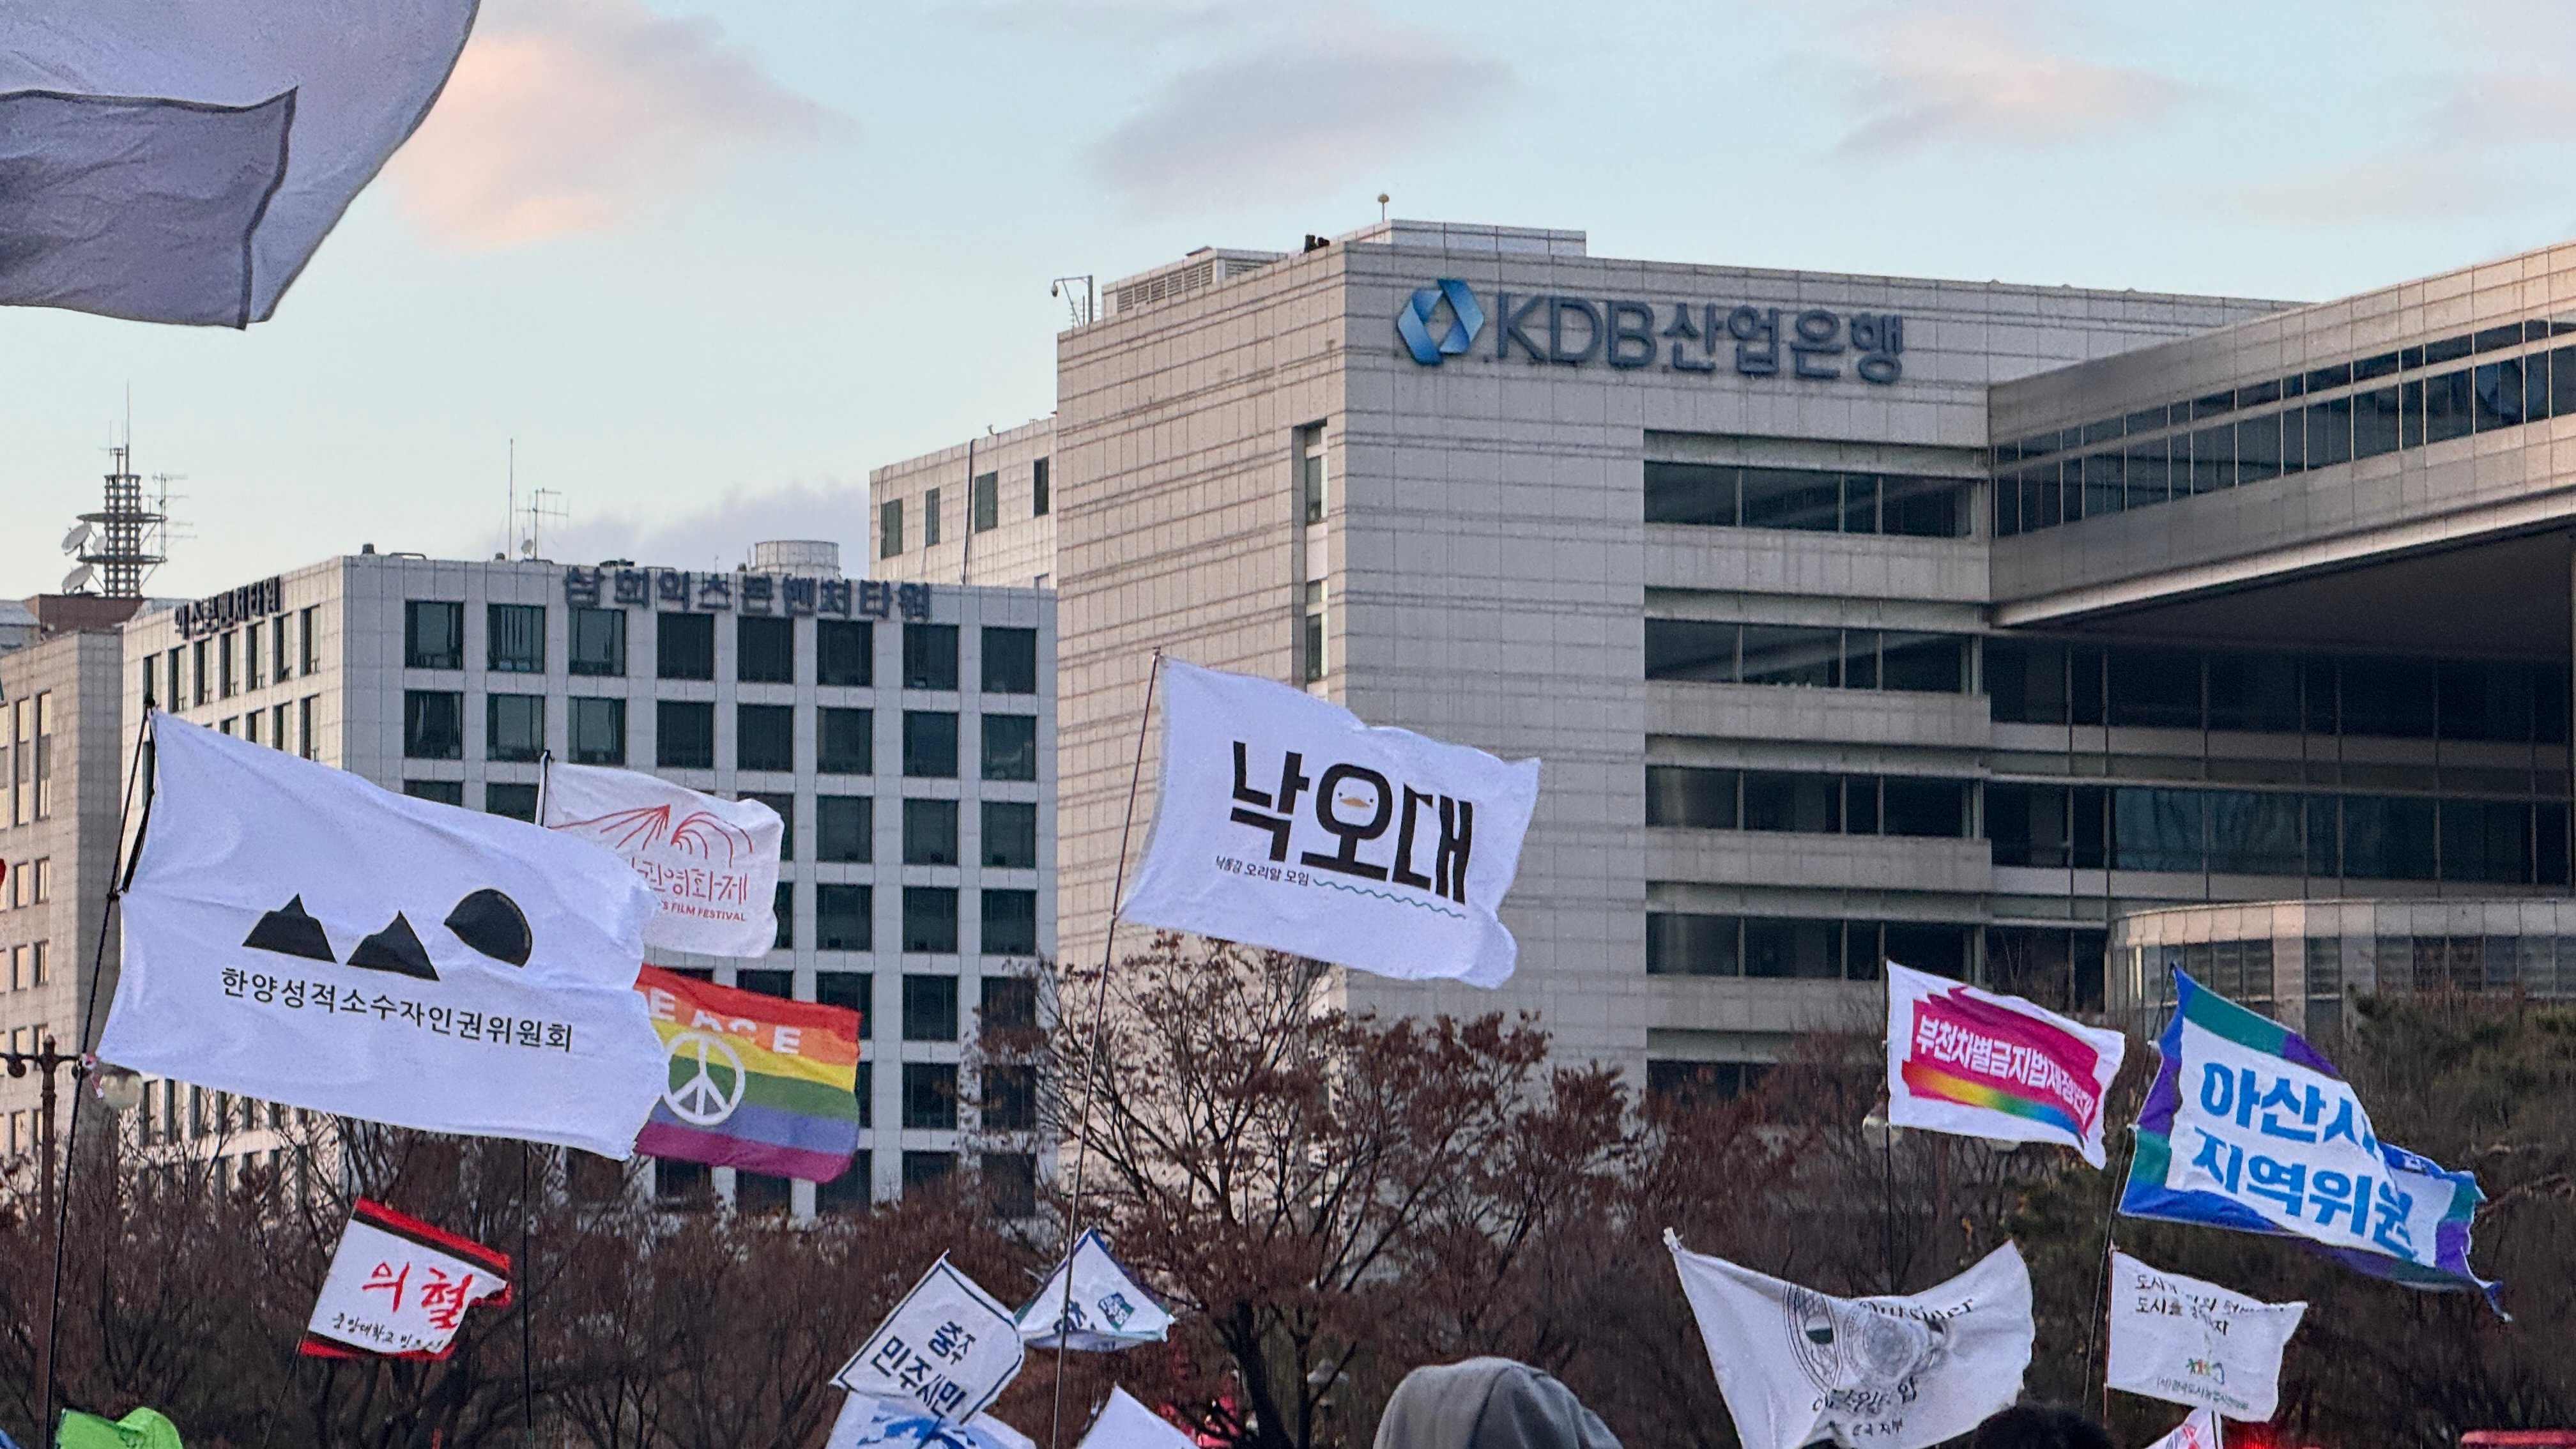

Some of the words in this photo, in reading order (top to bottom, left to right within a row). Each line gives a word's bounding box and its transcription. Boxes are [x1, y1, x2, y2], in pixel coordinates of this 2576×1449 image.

[1497, 291, 1904, 383] KDB산업은행
[1230, 740, 1473, 905] 낙오대
[671, 903, 695, 915] FILM
[698, 908, 746, 922] FESTIVAL
[1245, 863, 1282, 882] 오리알
[1284, 870, 1309, 886] 모임
[221, 967, 572, 1053] 한양성적소수자인권위원회
[649, 987, 801, 1054] EACE
[870, 1335, 967, 1418] 민주시민
